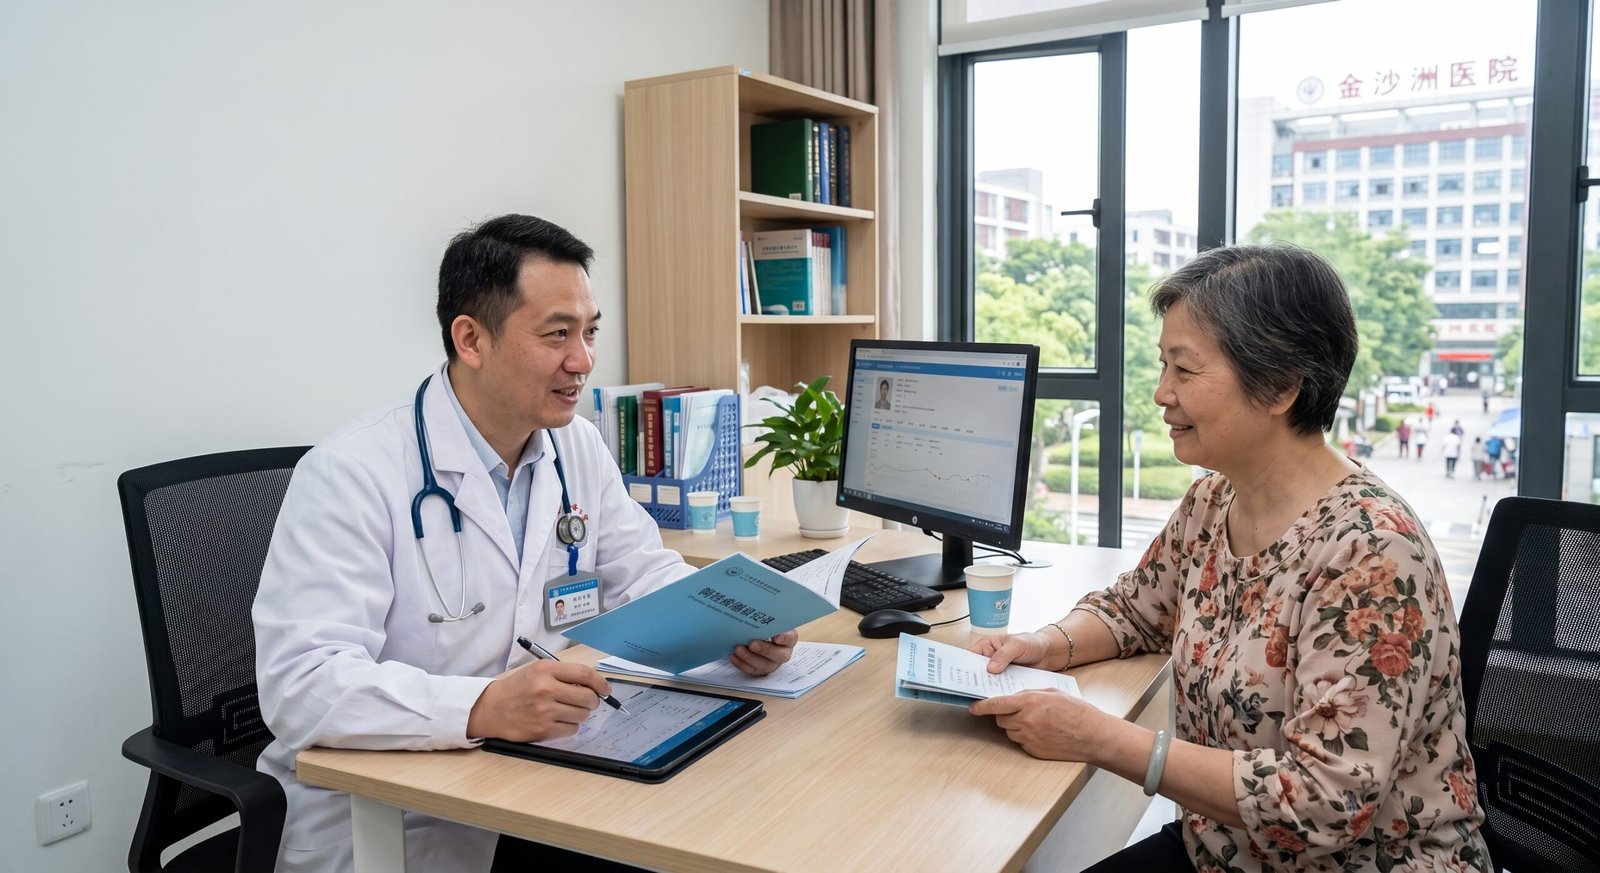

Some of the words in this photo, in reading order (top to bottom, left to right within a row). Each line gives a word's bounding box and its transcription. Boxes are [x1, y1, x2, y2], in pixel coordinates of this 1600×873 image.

[1338, 56, 1518, 99] 金沙洲医院
